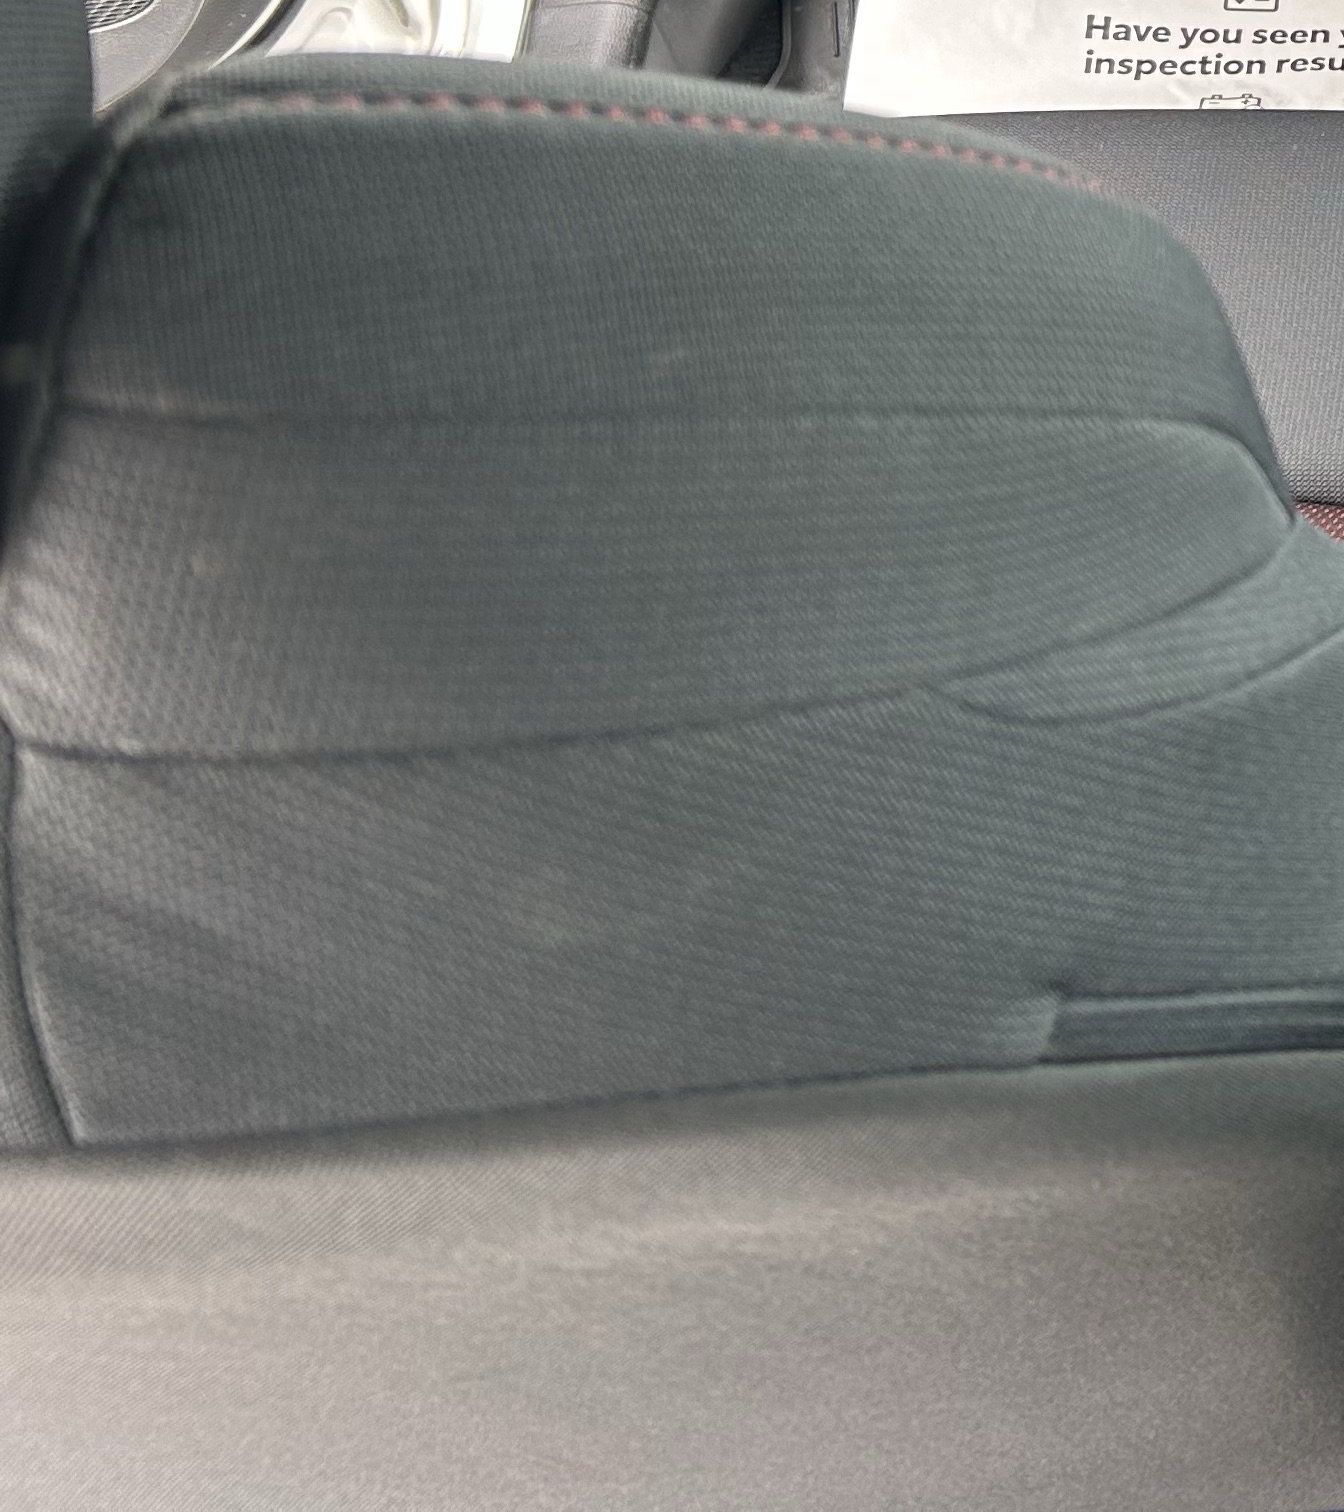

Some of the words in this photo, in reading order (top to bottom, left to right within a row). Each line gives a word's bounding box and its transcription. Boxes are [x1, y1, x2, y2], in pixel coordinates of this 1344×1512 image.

[1084, 14, 1171, 43] Have
[1178, 27, 1243, 49] you
[1251, 29, 1330, 44] seen
[1084, 50, 1266, 81] inspection
